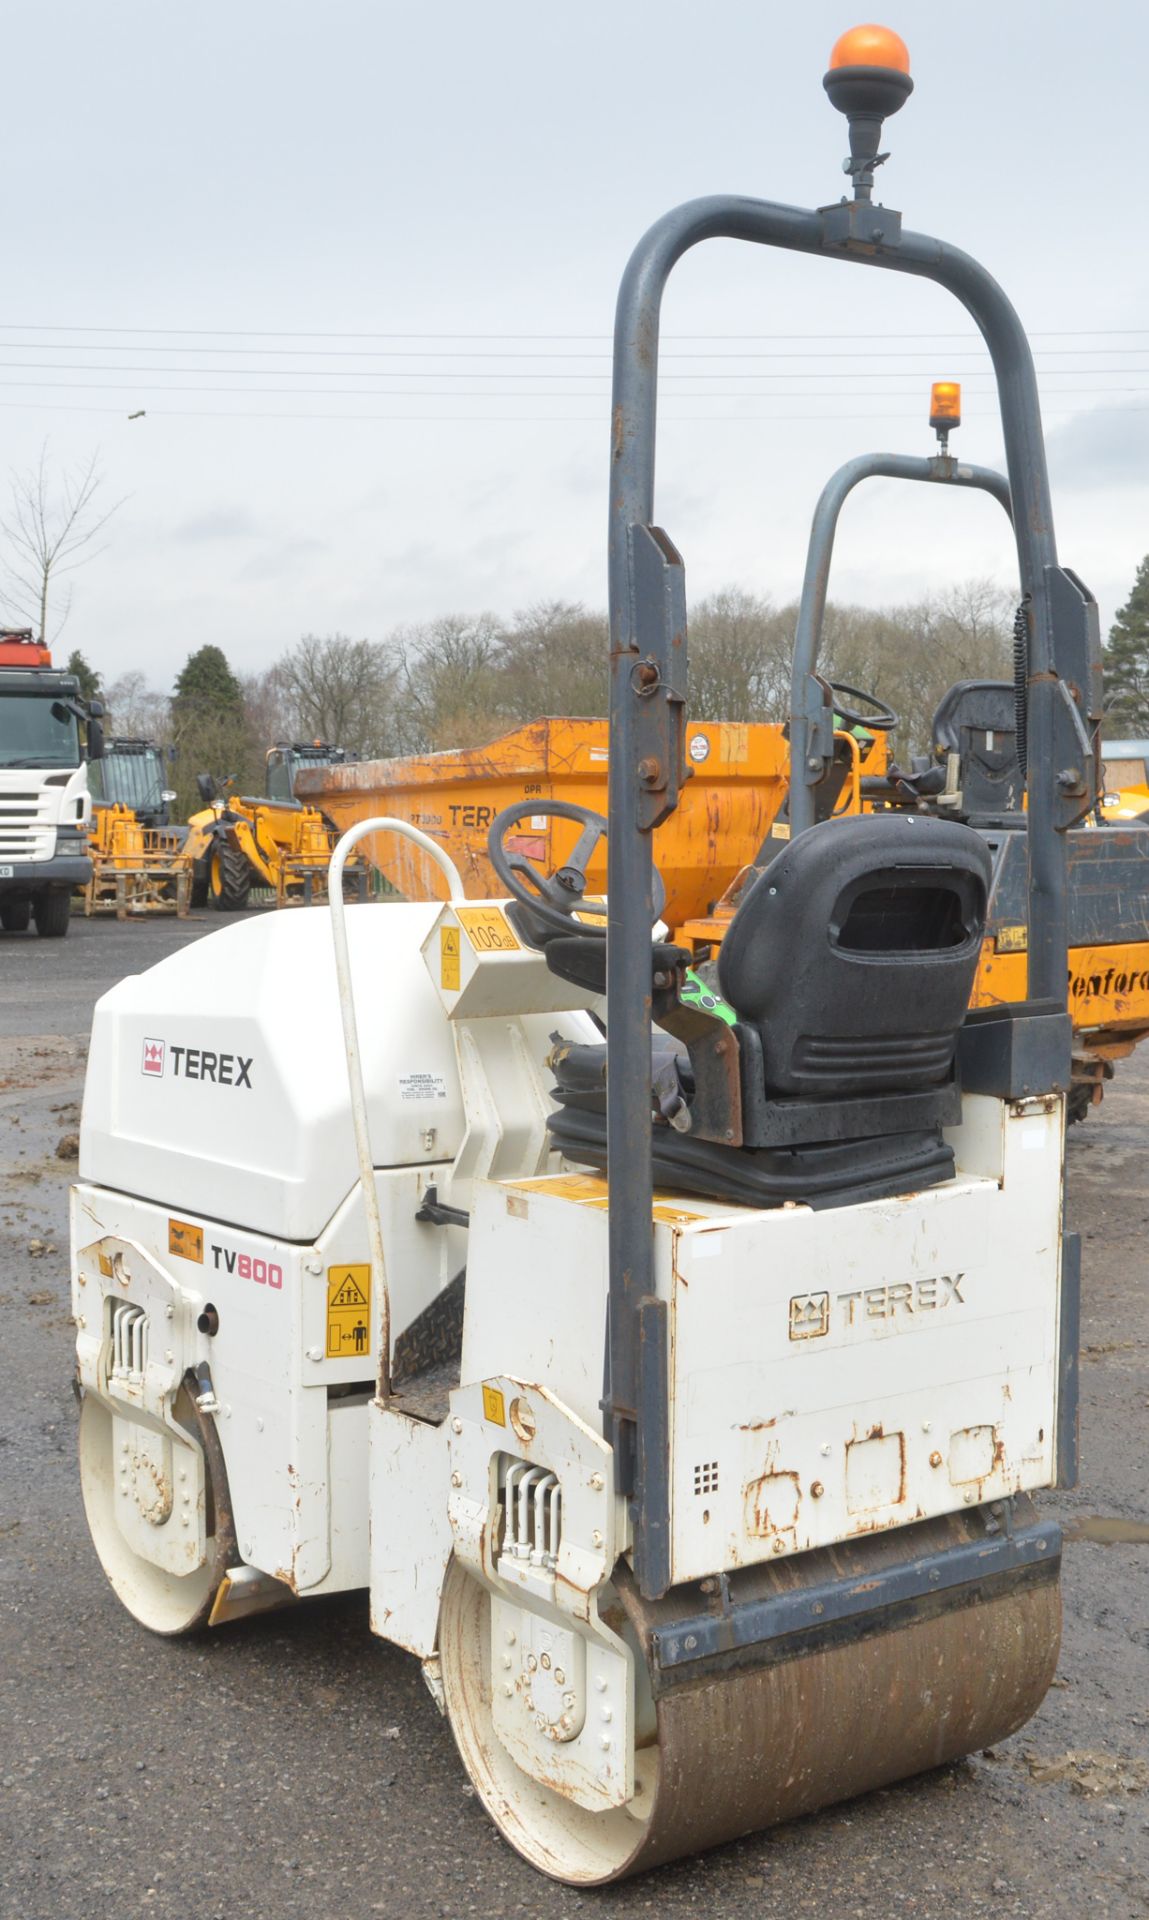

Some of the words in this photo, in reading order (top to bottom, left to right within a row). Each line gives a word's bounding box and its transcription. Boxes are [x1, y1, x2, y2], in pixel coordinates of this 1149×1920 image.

[448, 805, 522, 829] TER
[470, 926, 502, 948] 106
[170, 1046, 253, 1089] TEREX
[211, 1245, 282, 1290] TV800
[837, 1273, 965, 1325] TEREX
